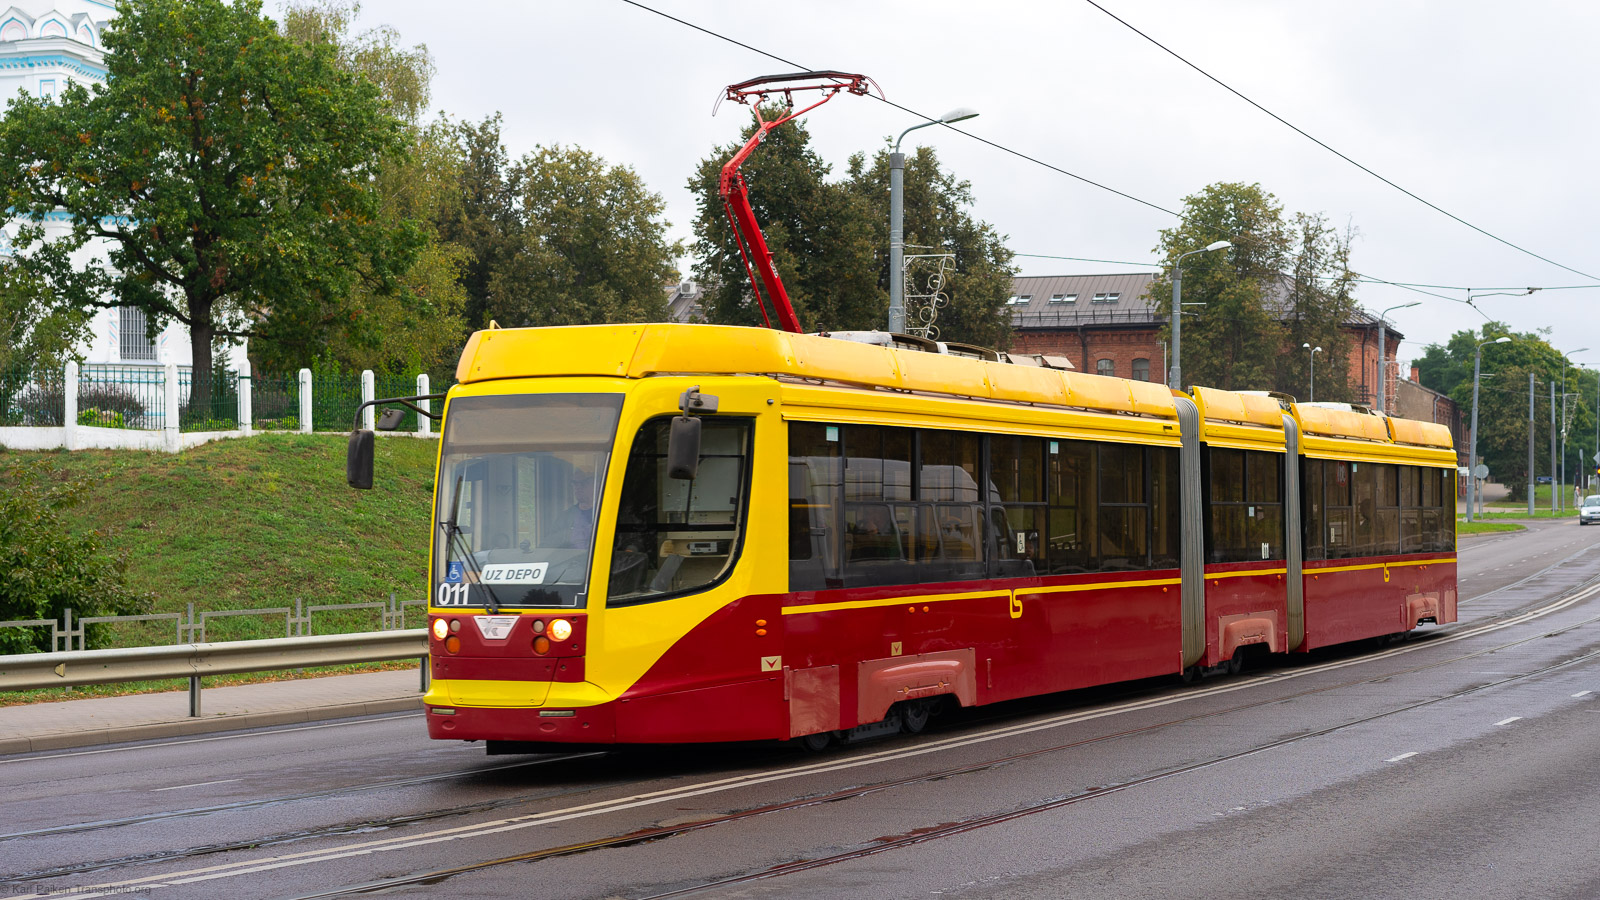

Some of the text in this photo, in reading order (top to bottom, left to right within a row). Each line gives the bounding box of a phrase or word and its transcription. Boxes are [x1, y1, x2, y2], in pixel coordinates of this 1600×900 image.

[485, 568, 541, 581] UZ DEPO
[438, 582, 470, 605] 011
